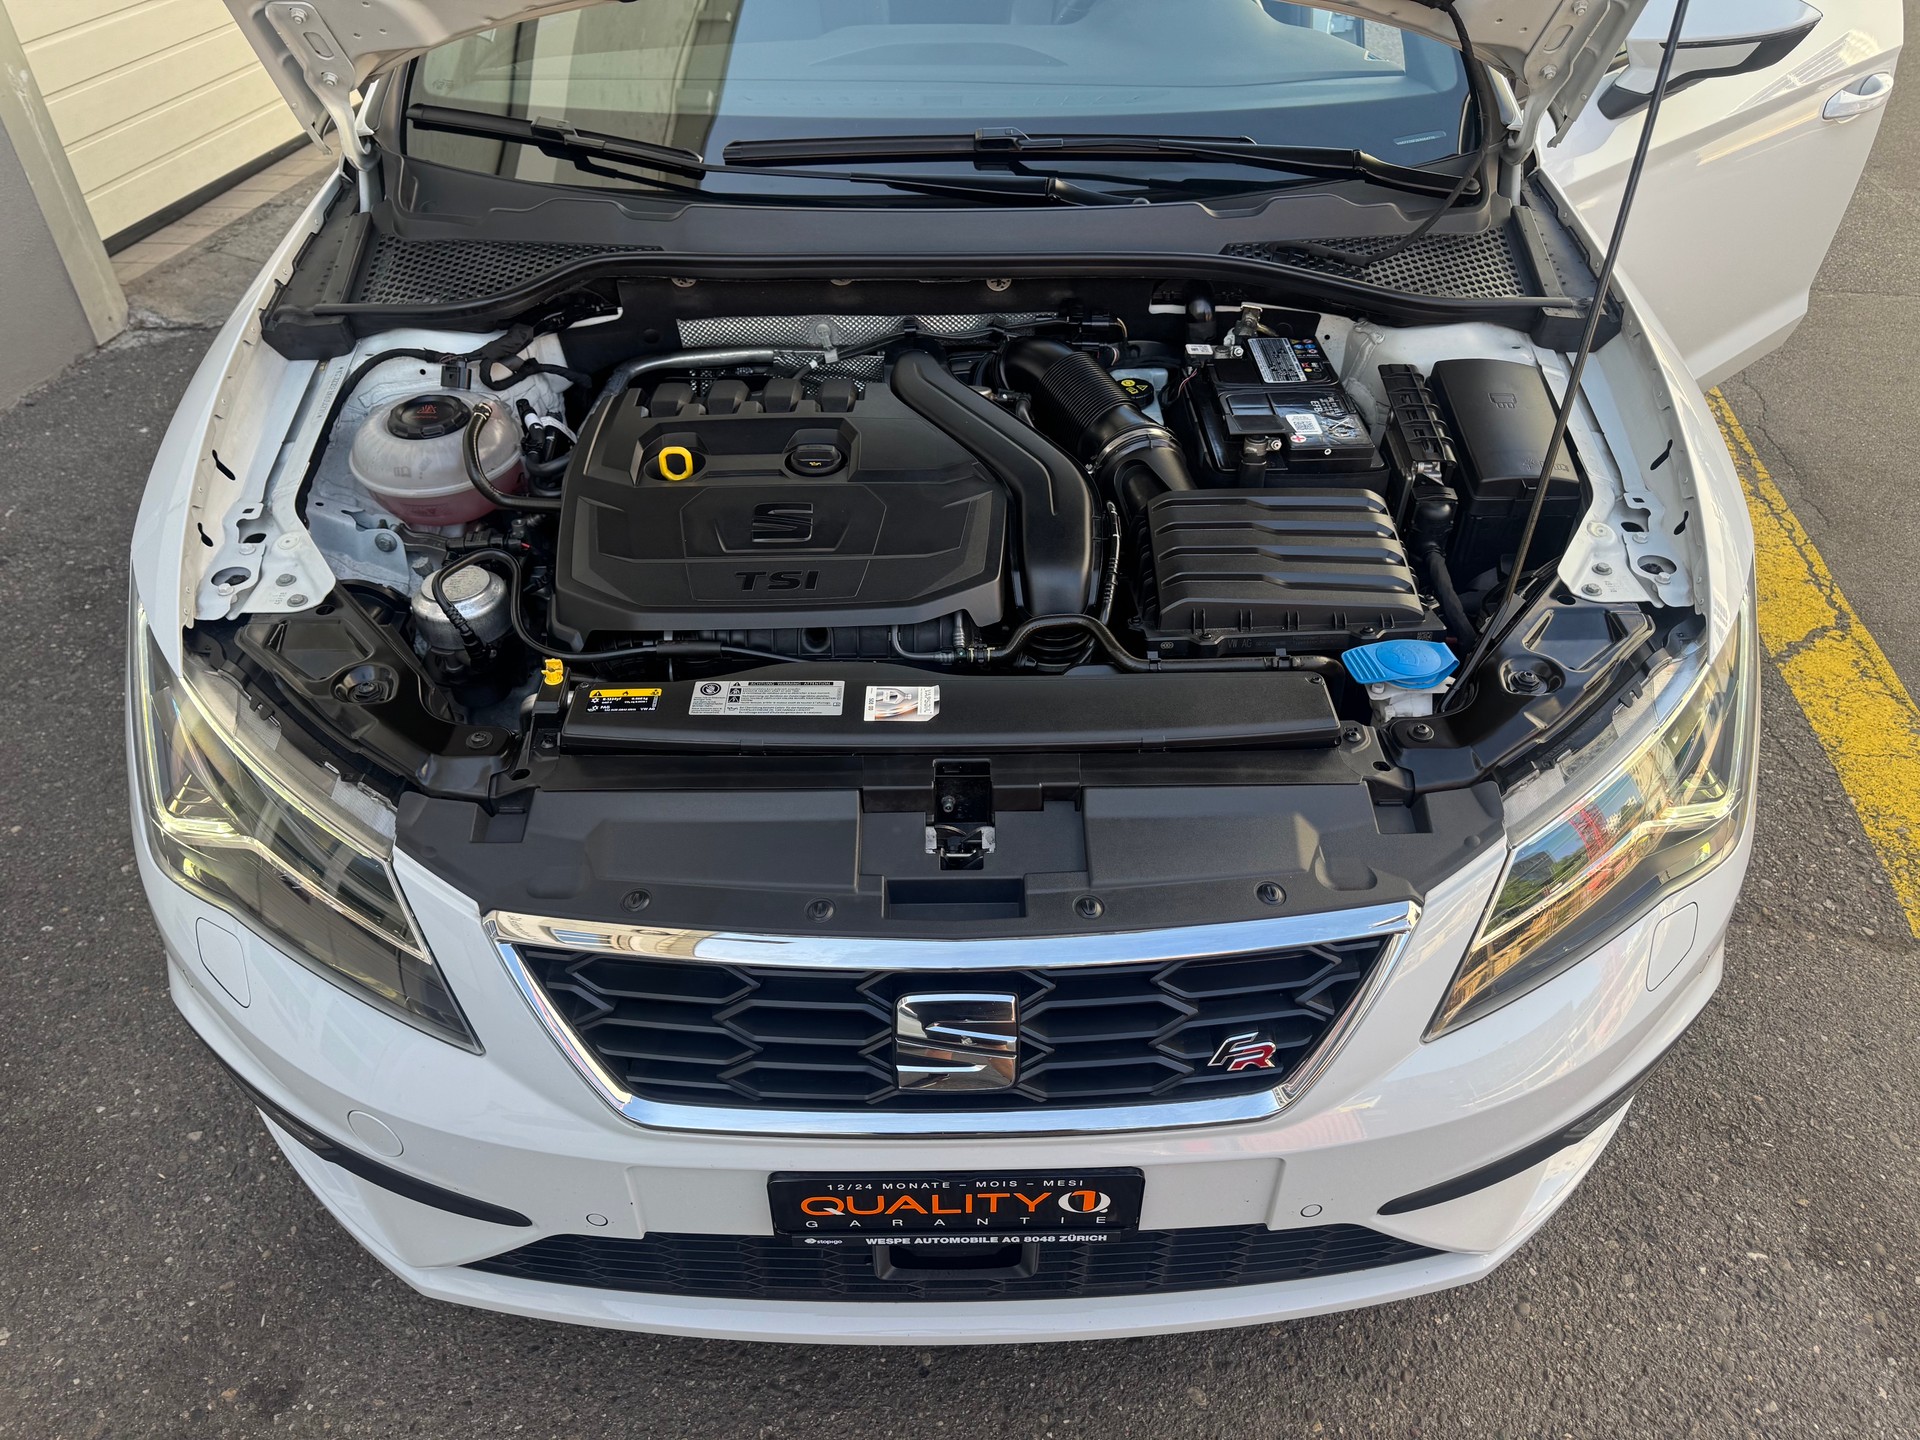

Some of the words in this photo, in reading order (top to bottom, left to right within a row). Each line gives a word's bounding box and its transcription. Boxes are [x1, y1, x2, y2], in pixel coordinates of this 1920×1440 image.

[735, 569, 820, 592] TSI
[1207, 1031, 1276, 1071] FR
[827, 1183, 873, 1191] 12/24
[882, 1182, 950, 1190] MONATE
[975, 1180, 1018, 1188] MOIS
[1043, 1179, 1083, 1187] MESI
[800, 1192, 1052, 1216] QUALITY
[805, 1216, 1106, 1228] GARANTIE
[865, 1237, 911, 1245] WESPE
[914, 1236, 999, 1244] AUTOMOBILE
[1058, 1234, 1107, 1242] ZÜRICH
